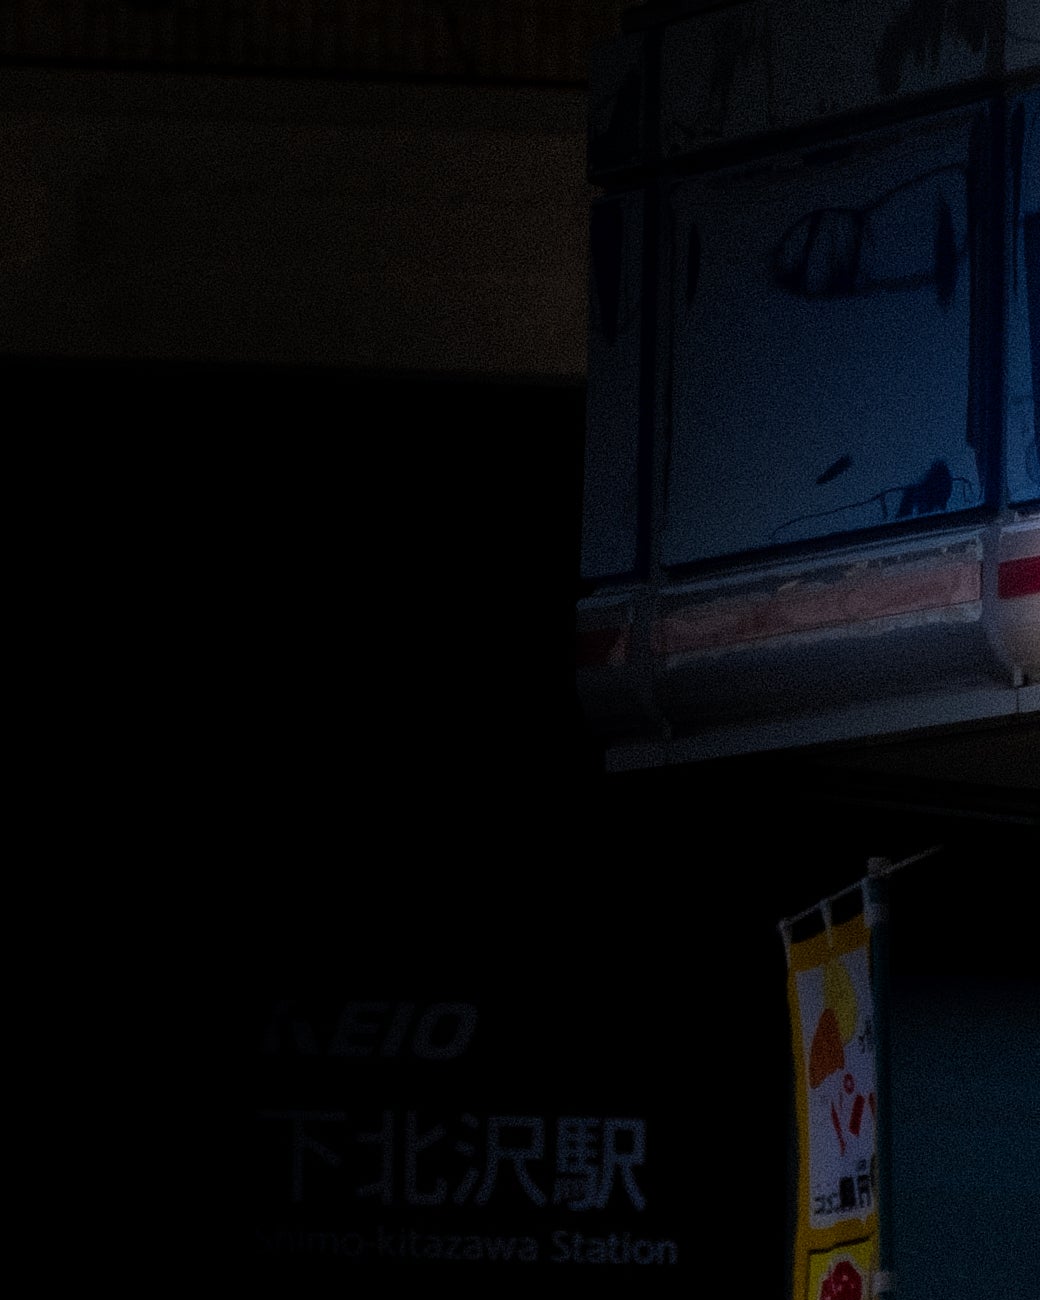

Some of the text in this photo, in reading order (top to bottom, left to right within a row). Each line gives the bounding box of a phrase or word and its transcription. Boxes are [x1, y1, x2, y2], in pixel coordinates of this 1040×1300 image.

[256, 1108, 649, 1213] 下北沢駅
[550, 1228, 679, 1266] Station
